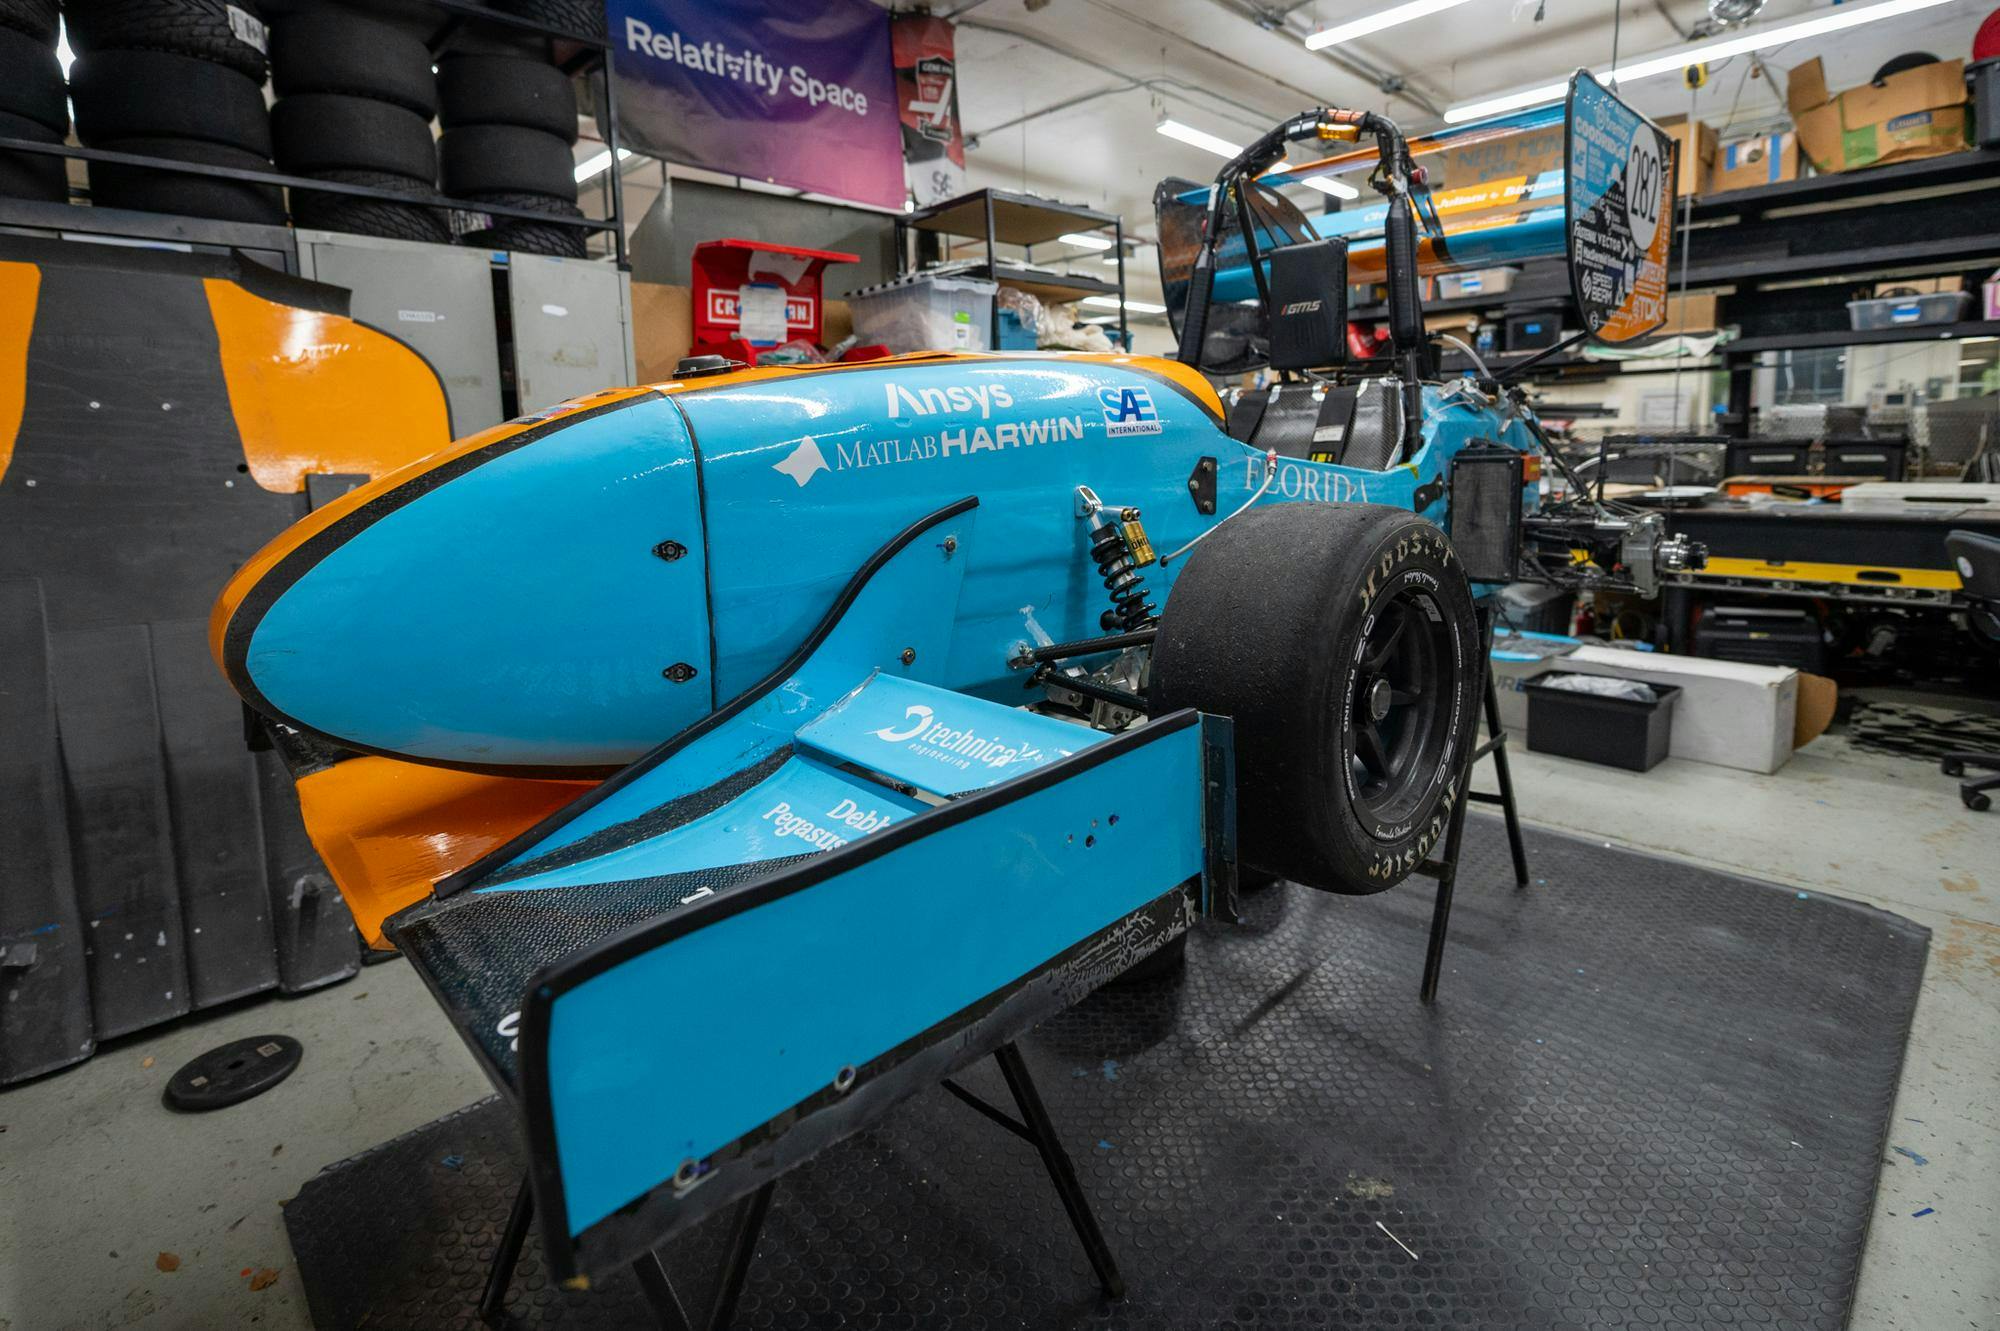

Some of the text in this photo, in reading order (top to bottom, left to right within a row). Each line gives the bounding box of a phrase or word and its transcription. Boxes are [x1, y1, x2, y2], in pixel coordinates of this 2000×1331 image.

[625, 16, 869, 116] Relativity Space
[1631, 144, 1659, 224] 282
[1591, 285, 1613, 306] BEAM
[1592, 271, 1613, 289] SPEED
[884, 382, 1015, 419] Ansys
[1099, 388, 1157, 422] SAE
[835, 436, 938, 471] MATLAB
[1342, 668, 1356, 733] RACING
[1451, 681, 1463, 735] RACING
[907, 742, 971, 770] engineering
